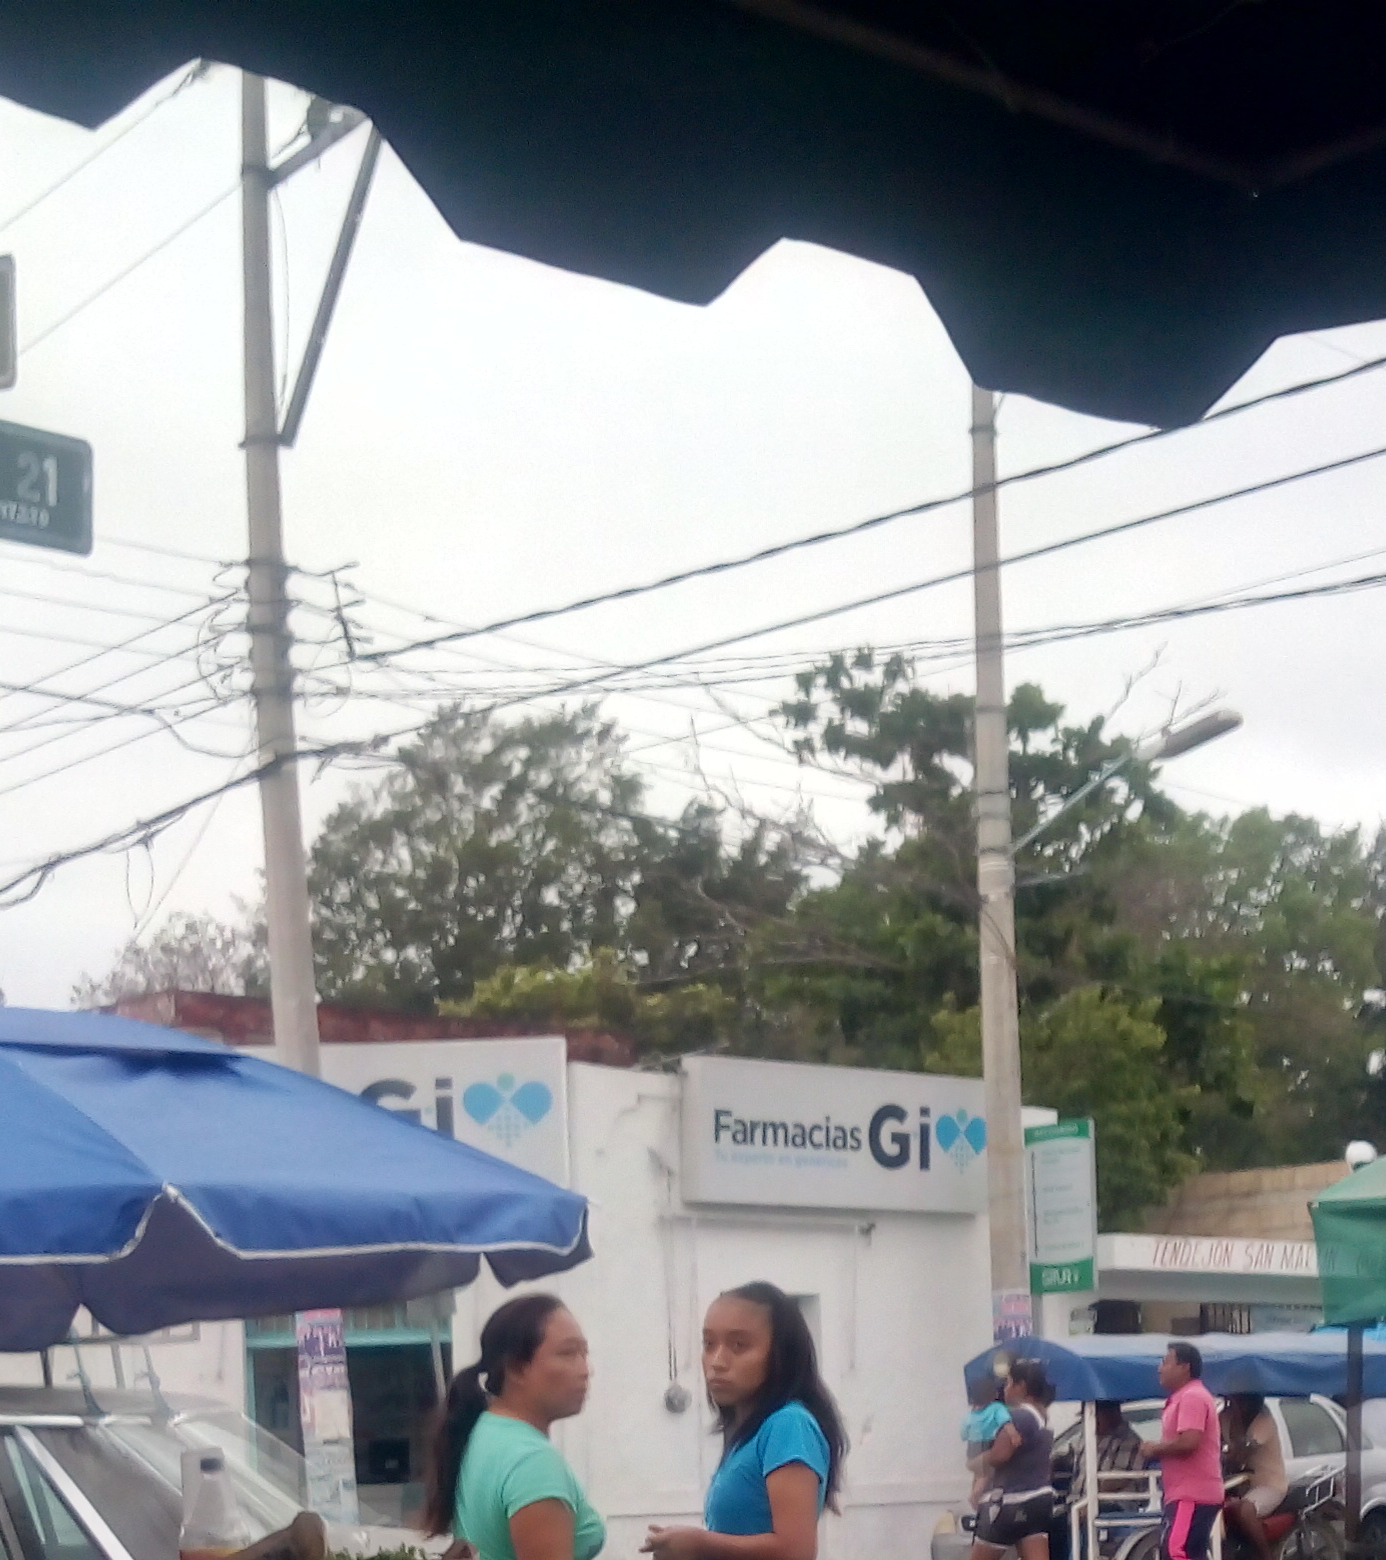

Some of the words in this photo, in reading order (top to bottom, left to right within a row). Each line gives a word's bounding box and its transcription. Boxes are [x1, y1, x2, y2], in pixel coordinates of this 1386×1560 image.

[15, 451, 61, 508] 21
[713, 1107, 862, 1153] Farmacias
[868, 1102, 932, 1172] Gi
[1244, 1243, 1274, 1271] SAN
